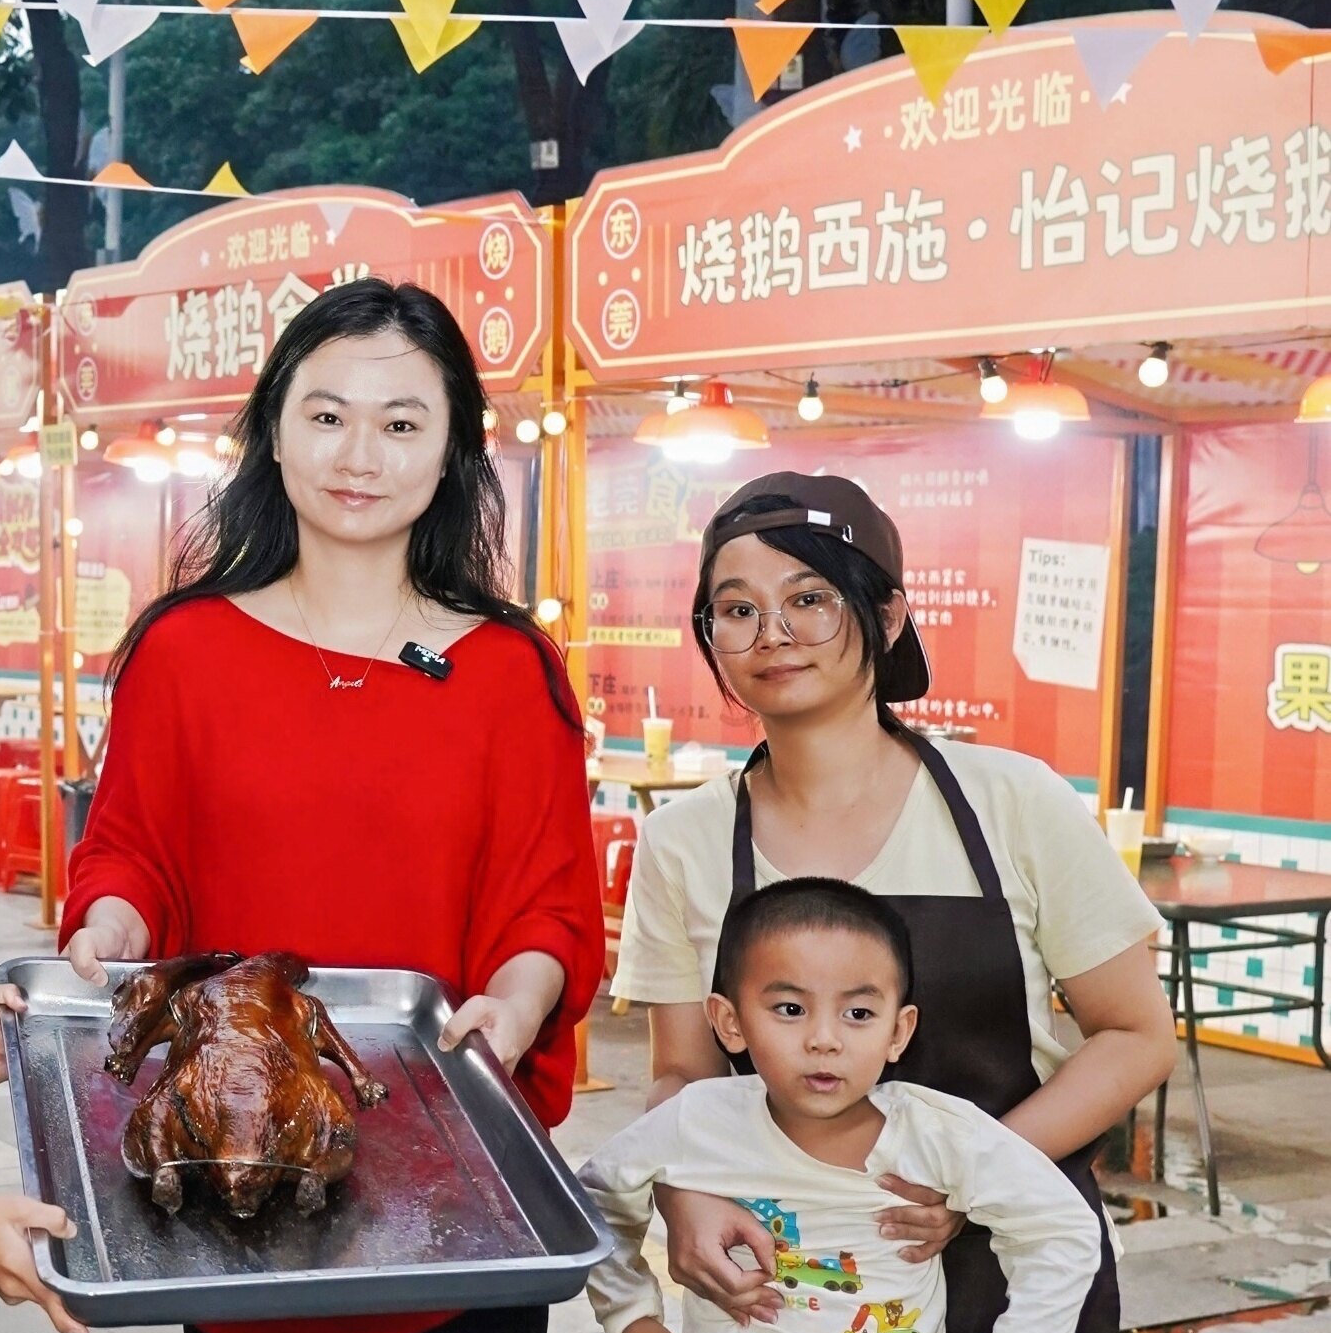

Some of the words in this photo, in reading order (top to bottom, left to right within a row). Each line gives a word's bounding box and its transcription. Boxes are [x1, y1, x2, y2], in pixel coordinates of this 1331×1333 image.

[899, 71, 1074, 150] 欢迎光临
[227, 222, 311, 268] 欢迎光临
[607, 209, 636, 342] 东莞
[483, 239, 509, 356] 烧鹅
[1028, 549, 1066, 567] Tips:
[1272, 648, 1331, 727] 果
